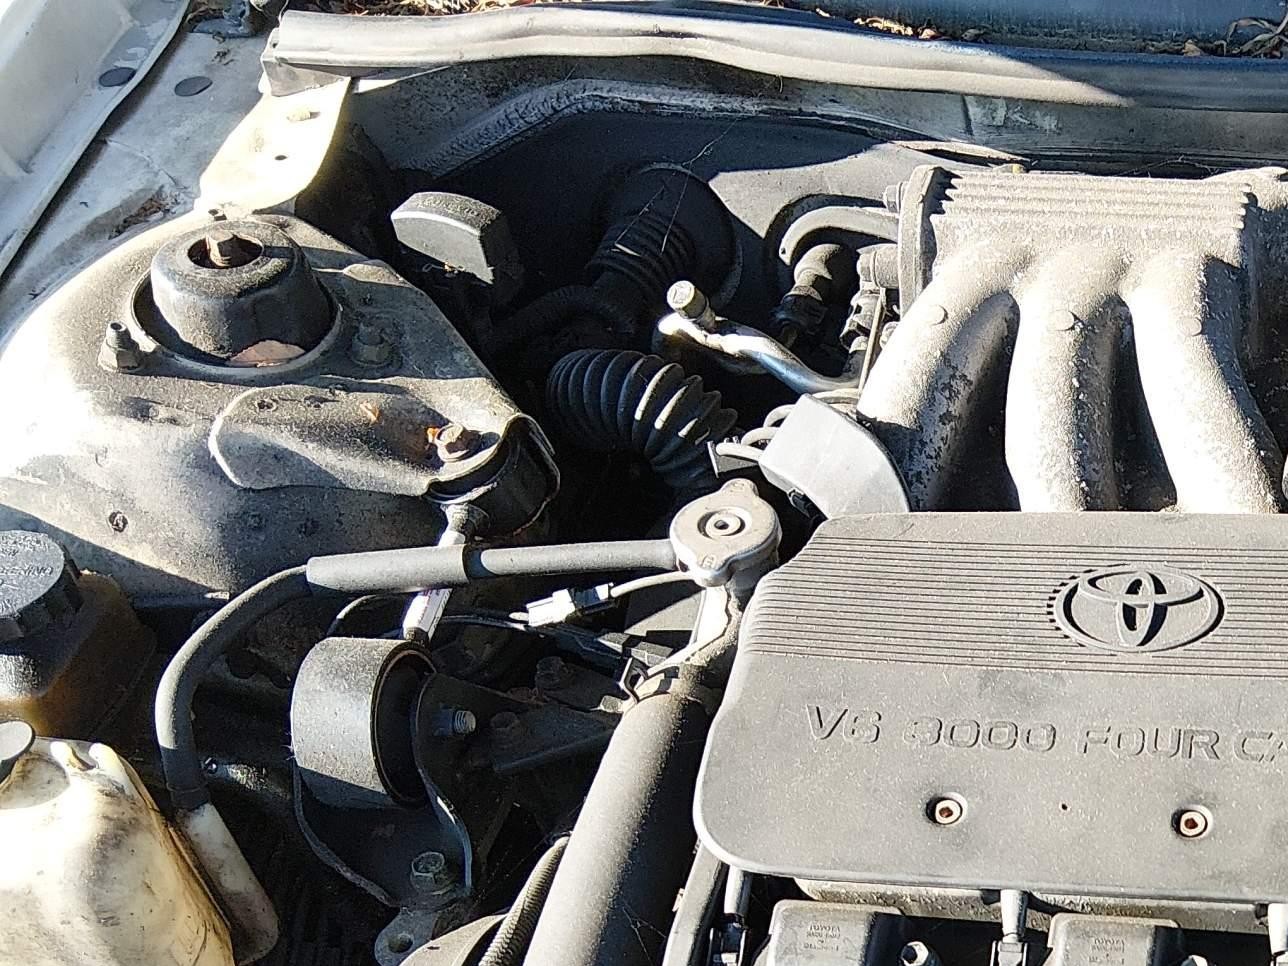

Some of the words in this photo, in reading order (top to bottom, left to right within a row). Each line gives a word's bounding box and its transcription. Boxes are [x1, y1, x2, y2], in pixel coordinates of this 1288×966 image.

[807, 702, 883, 745] V6
[902, 715, 1057, 753] 3000
[1074, 723, 1221, 762] FOUR
